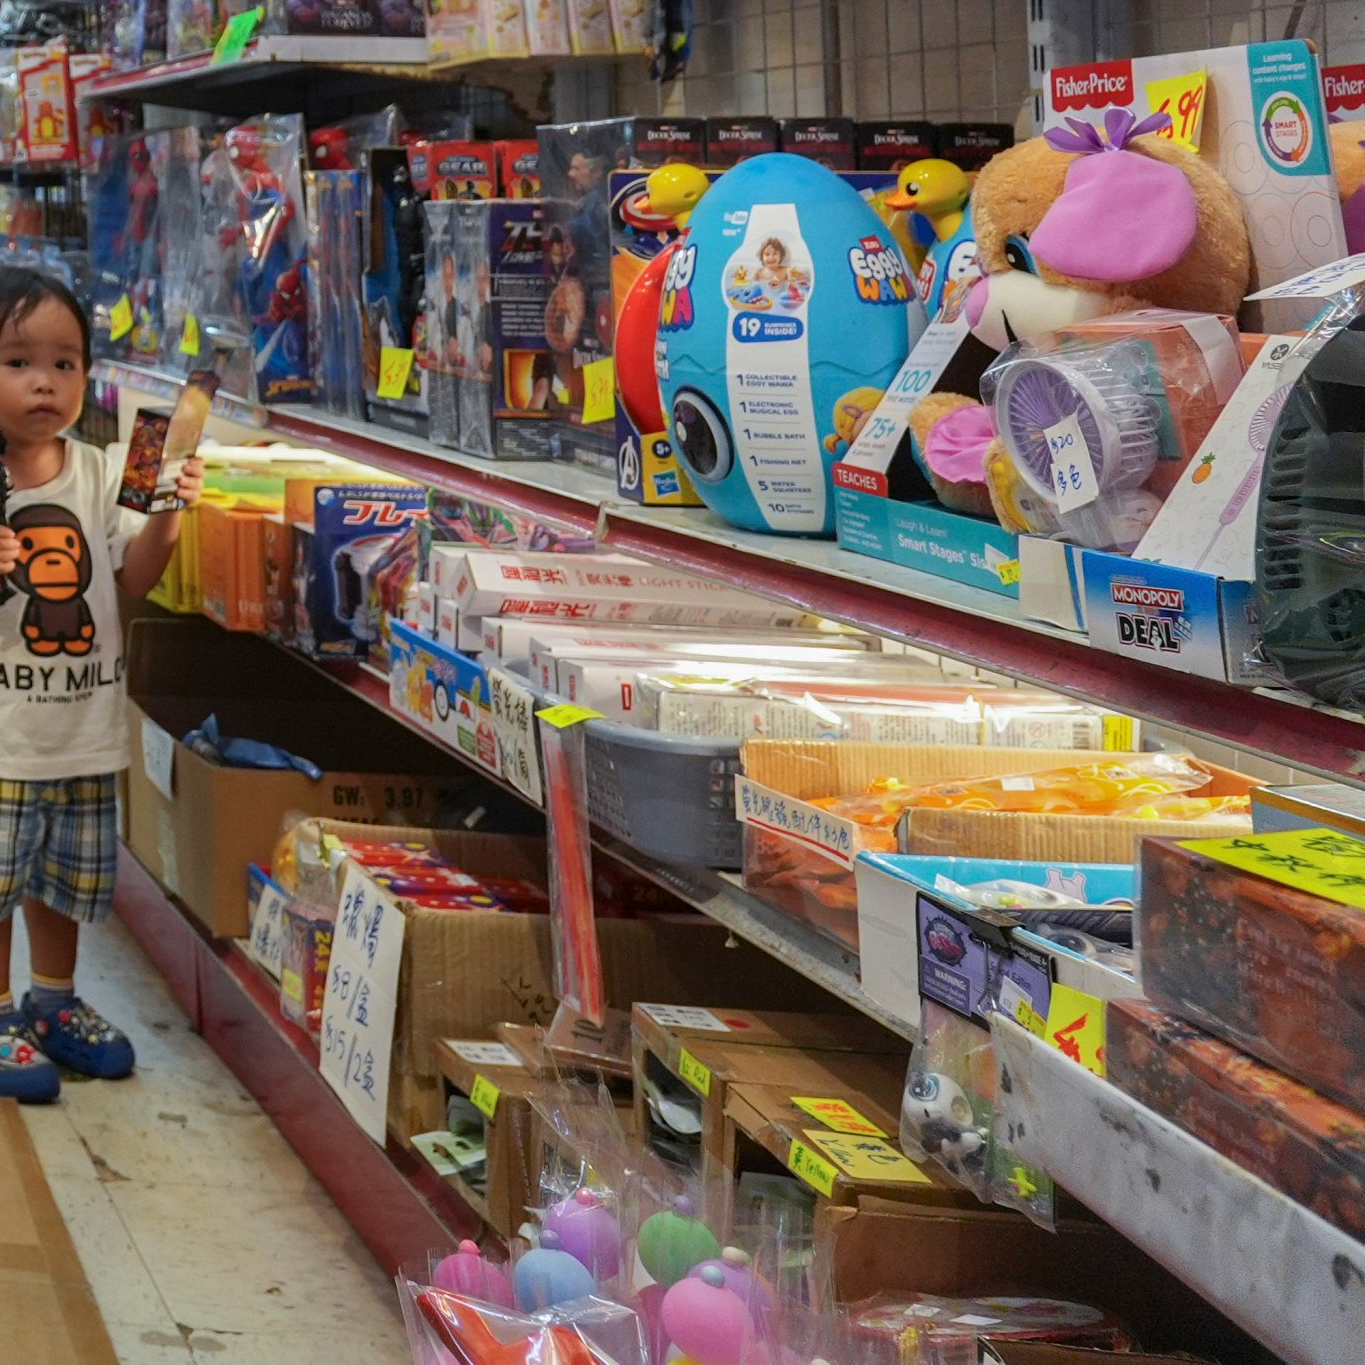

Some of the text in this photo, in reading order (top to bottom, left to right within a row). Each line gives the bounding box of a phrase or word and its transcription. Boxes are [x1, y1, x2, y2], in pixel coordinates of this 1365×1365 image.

[1055, 72, 1128, 98] Fisher-Price
[1274, 121, 1298, 130] SMART
[850, 245, 902, 279] Eggy
[738, 317, 762, 337] 19
[894, 370, 932, 393] 100
[836, 468, 878, 491] TEACHES
[899, 534, 928, 554] Smart
[1112, 585, 1184, 610] MONOPOLY
[1118, 614, 1181, 652] DEAL
[332, 785, 366, 806] GW:
